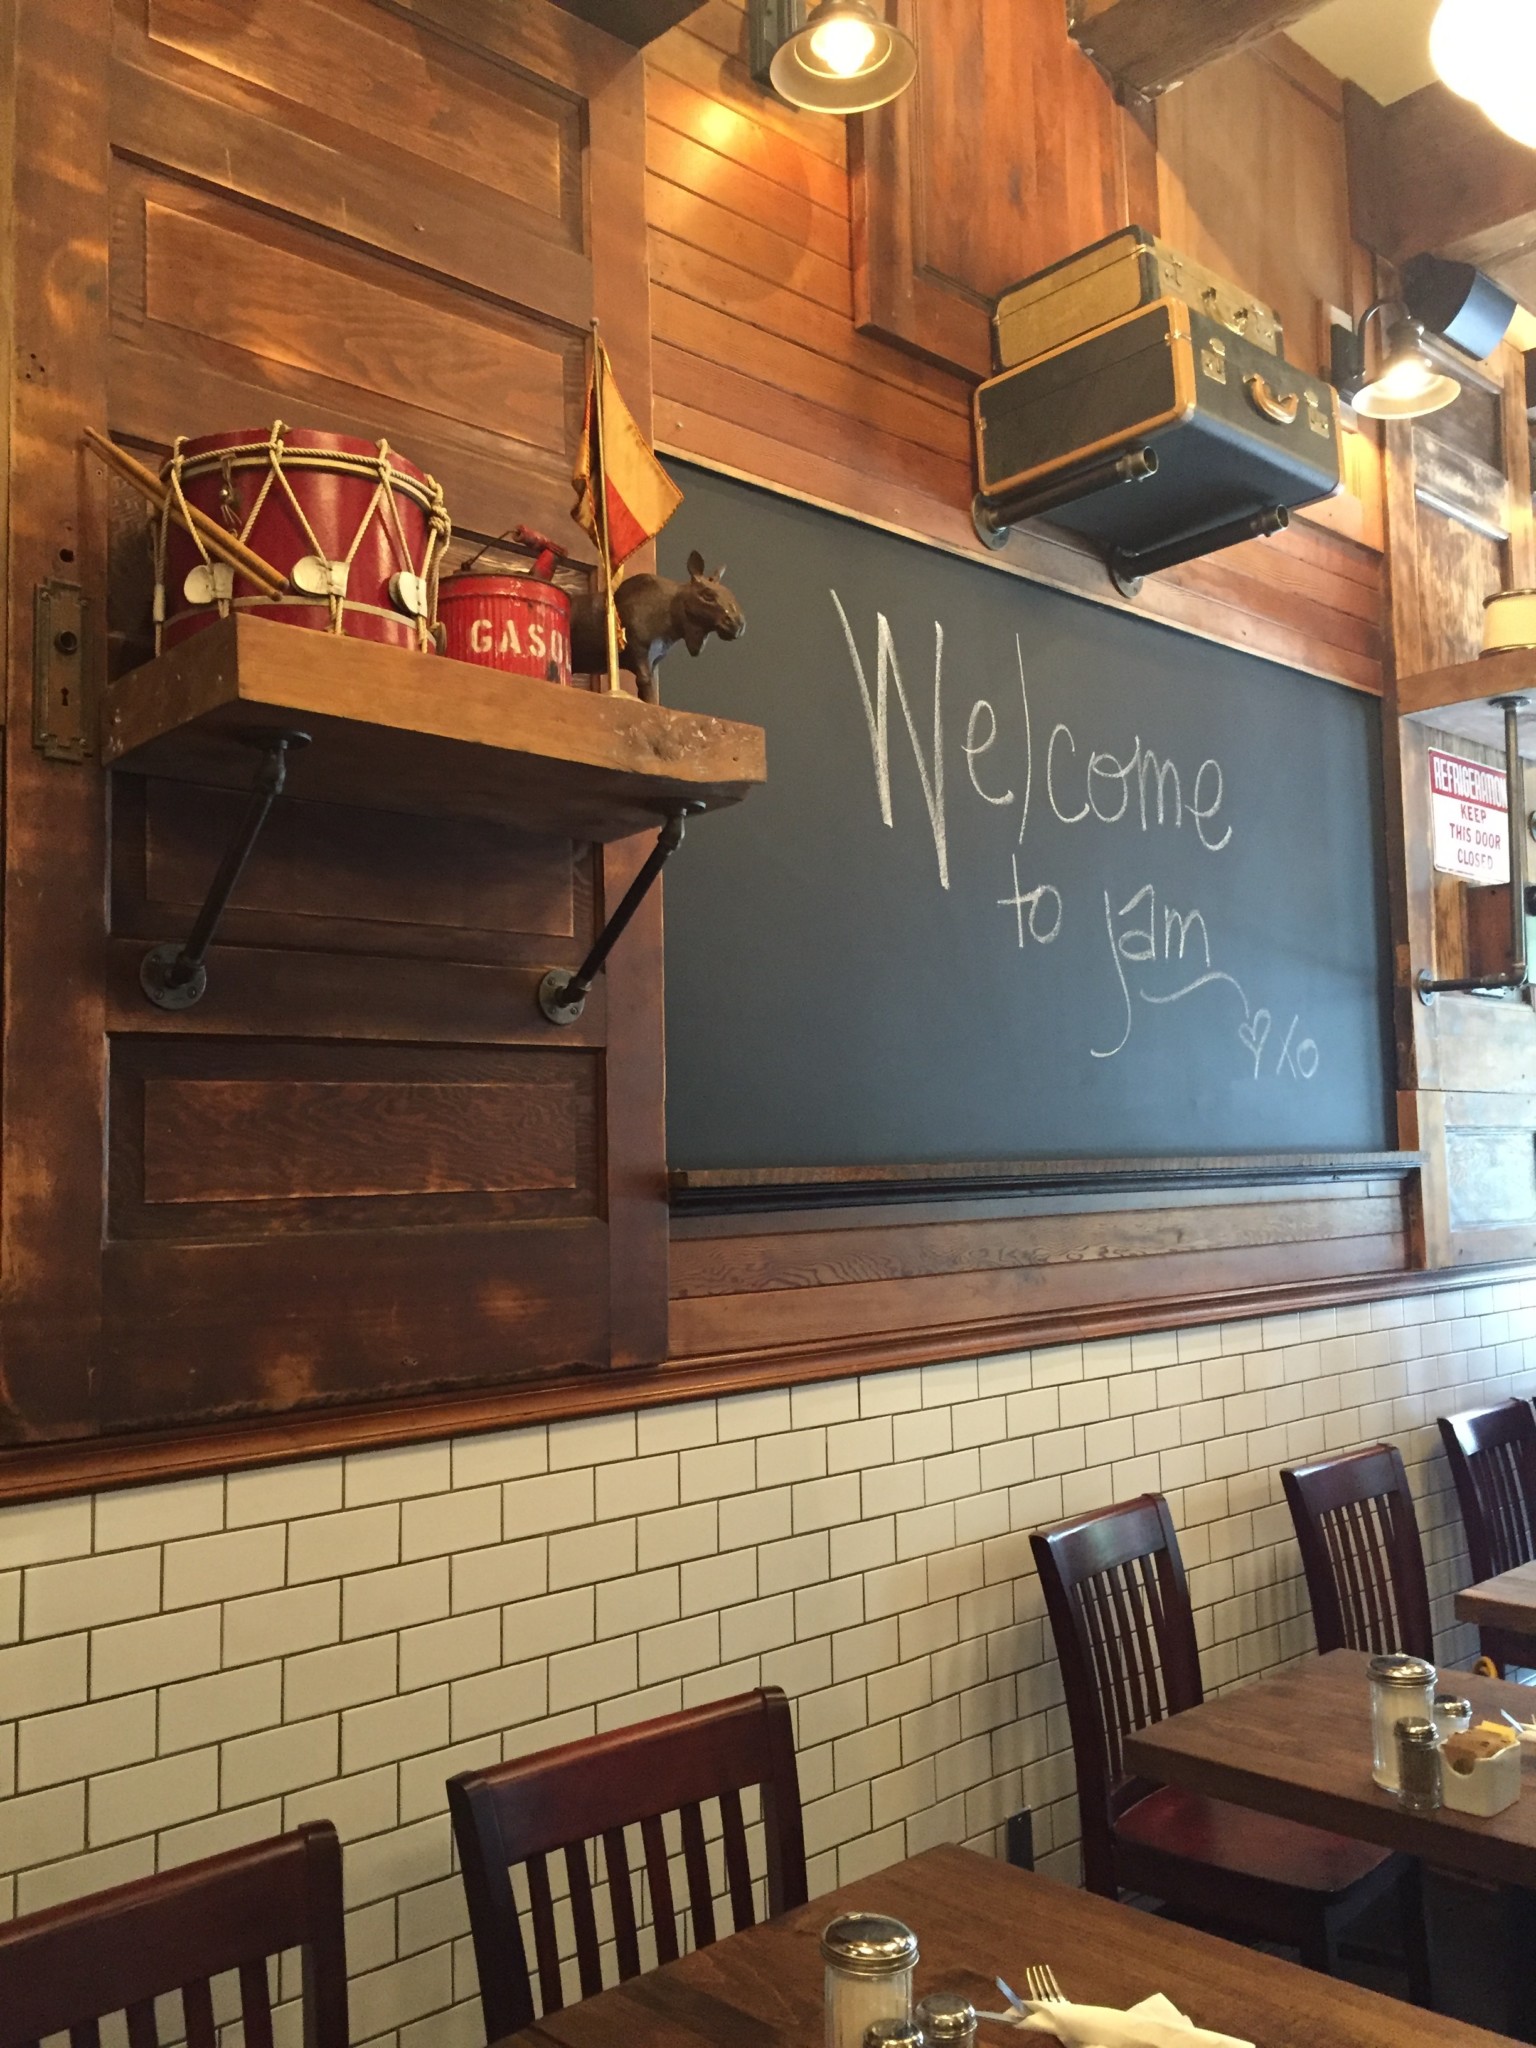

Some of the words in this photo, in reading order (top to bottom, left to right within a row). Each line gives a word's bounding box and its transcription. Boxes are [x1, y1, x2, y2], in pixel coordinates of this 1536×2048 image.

[829, 588, 1233, 890] Welcome
[1433, 756, 1508, 809] REFRIGERATION
[1460, 803, 1487, 823] KEEP
[1449, 822, 1472, 843] THIS
[1475, 829, 1501, 850] DOOR
[1457, 848, 1494, 870] CLOSED
[997, 853, 1062, 948] to
